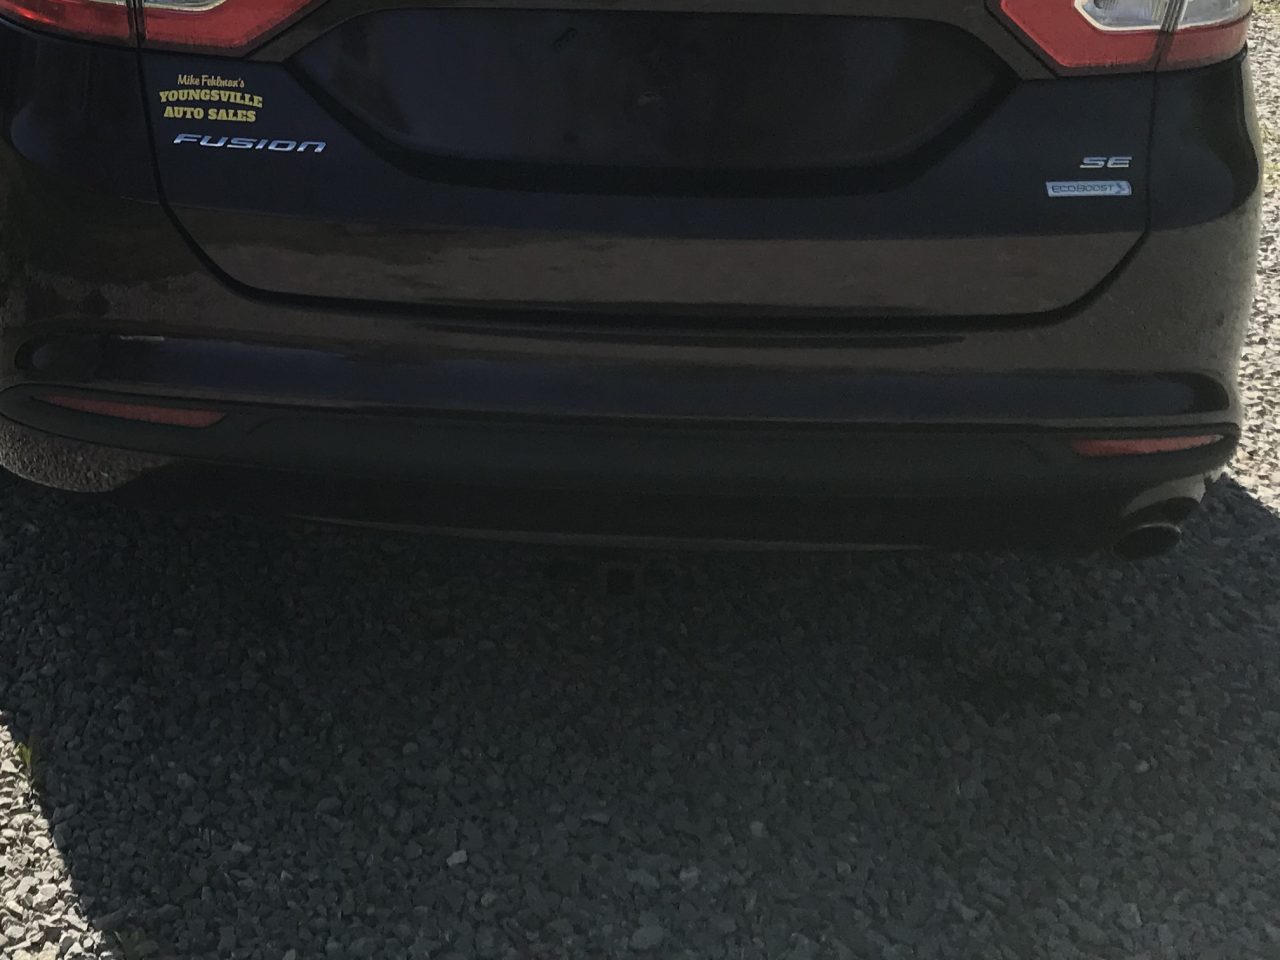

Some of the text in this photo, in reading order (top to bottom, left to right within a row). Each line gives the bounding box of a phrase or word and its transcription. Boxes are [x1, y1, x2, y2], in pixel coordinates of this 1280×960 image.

[177, 74, 200, 86] Mike
[159, 89, 263, 108] YOUNGSVILLE
[163, 106, 256, 122] AUTO SALES
[173, 133, 327, 153] FUSION
[1080, 156, 1132, 168] SE
[1051, 183, 1114, 194] ECOBOOST
